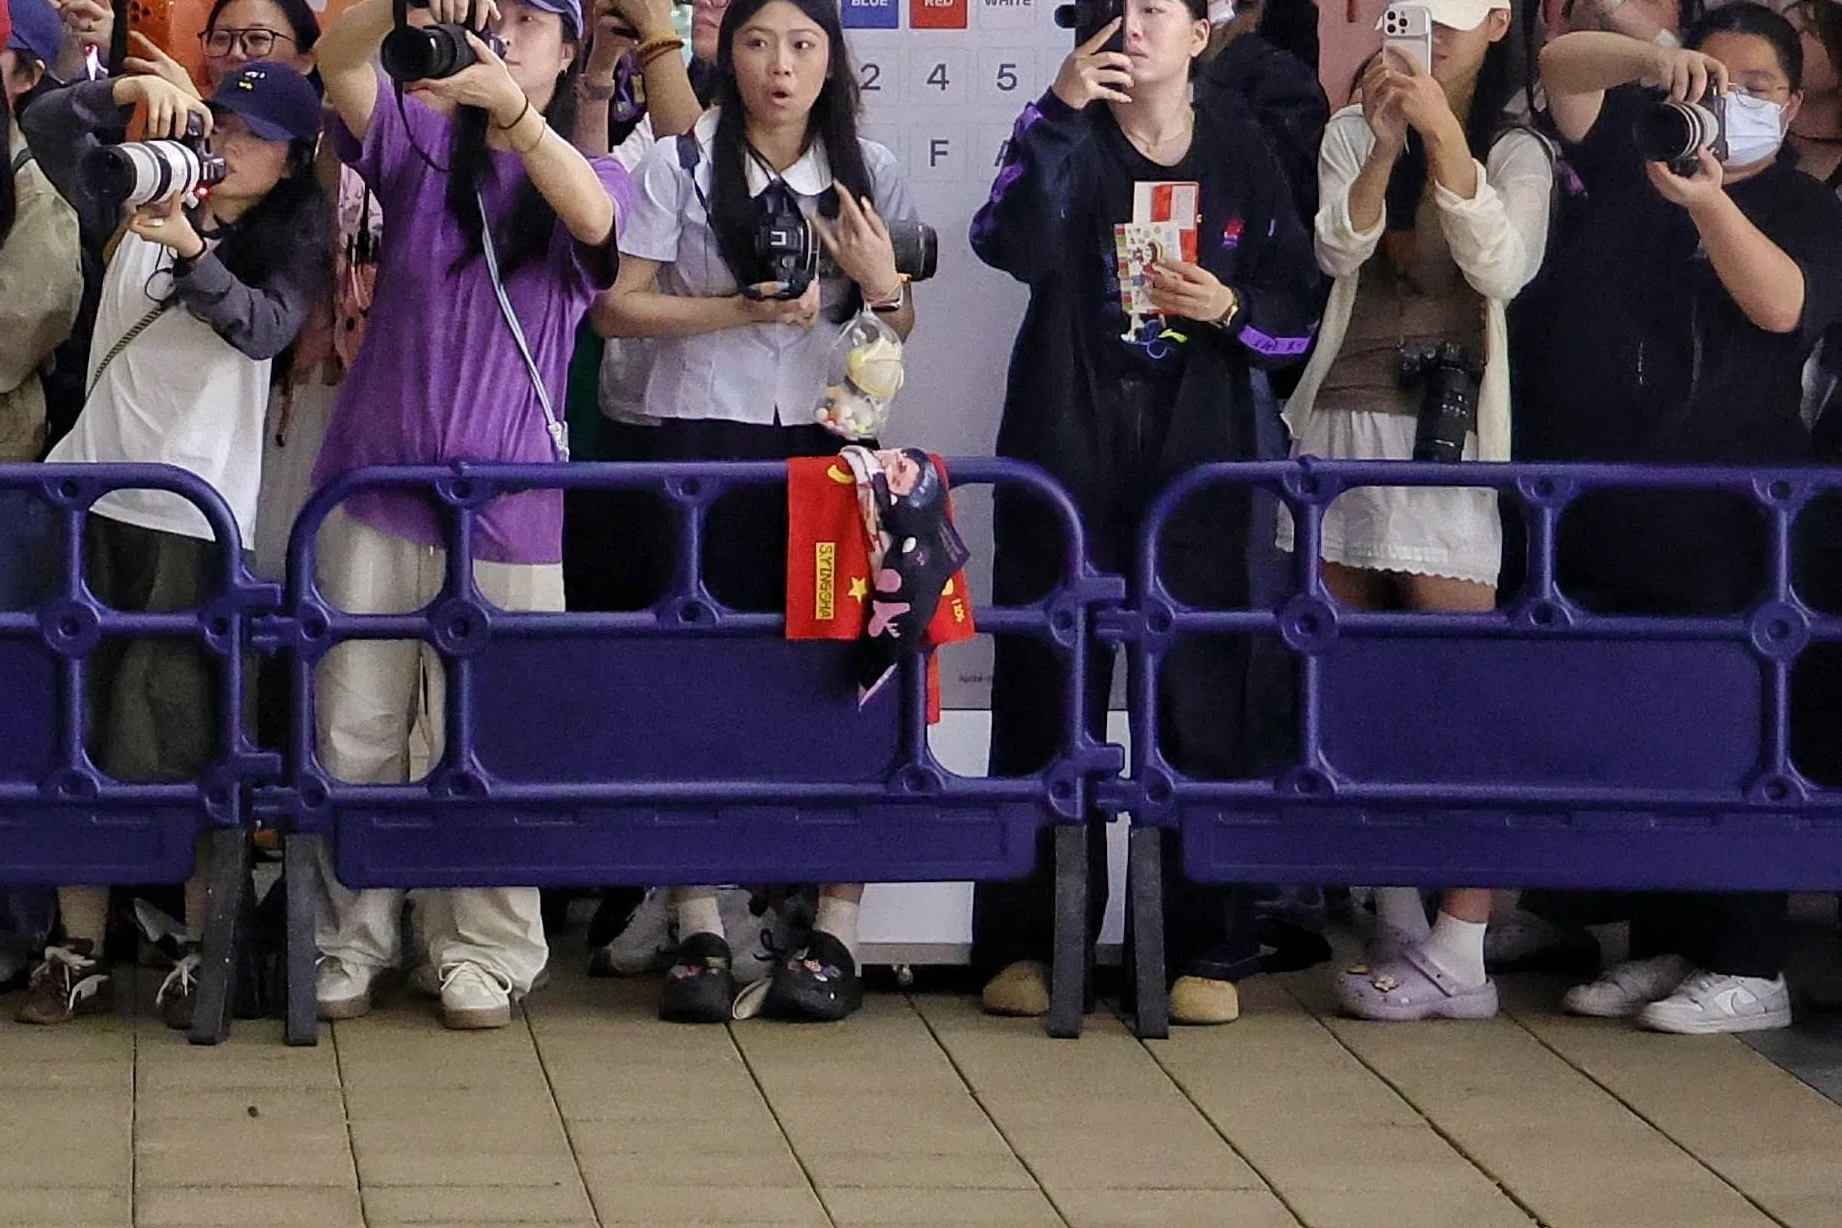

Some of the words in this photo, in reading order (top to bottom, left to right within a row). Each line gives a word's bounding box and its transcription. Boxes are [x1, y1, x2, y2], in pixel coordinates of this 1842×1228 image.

[859, 62, 882, 91] 2
[926, 62, 950, 91] 4
[996, 63, 1018, 92] 5
[929, 138, 949, 167] F
